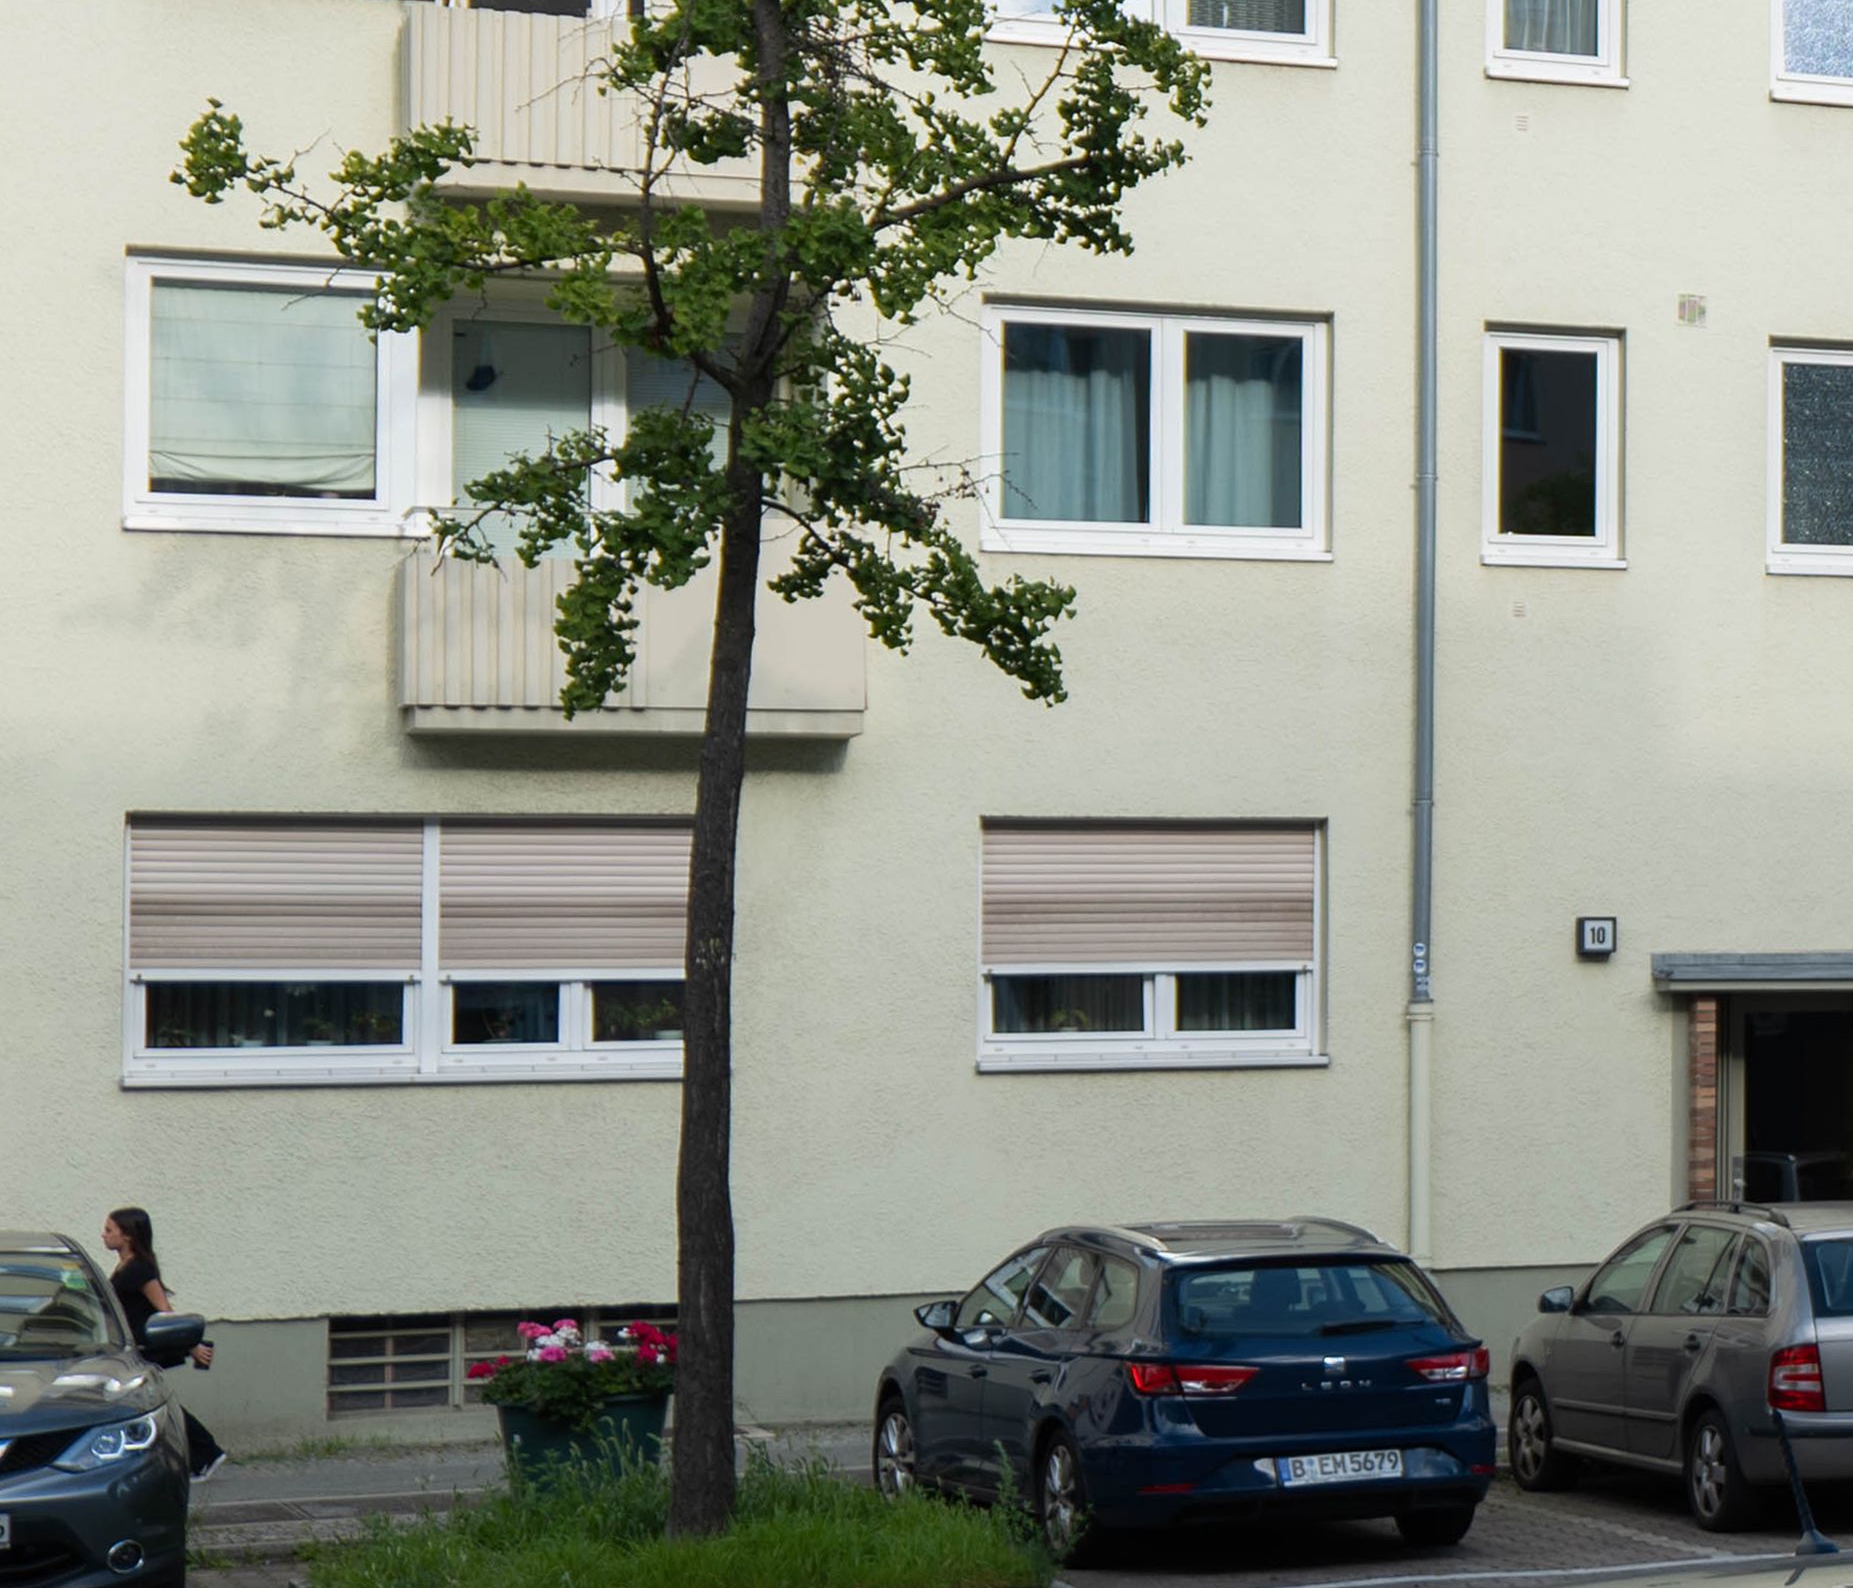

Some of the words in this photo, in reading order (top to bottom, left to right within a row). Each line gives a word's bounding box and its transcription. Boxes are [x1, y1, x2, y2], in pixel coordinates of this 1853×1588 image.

[1590, 926, 1605, 944] 10
[1291, 1458, 1306, 1478] B
[1318, 1455, 1347, 1476] EM
[1349, 1450, 1399, 1474] 5679
